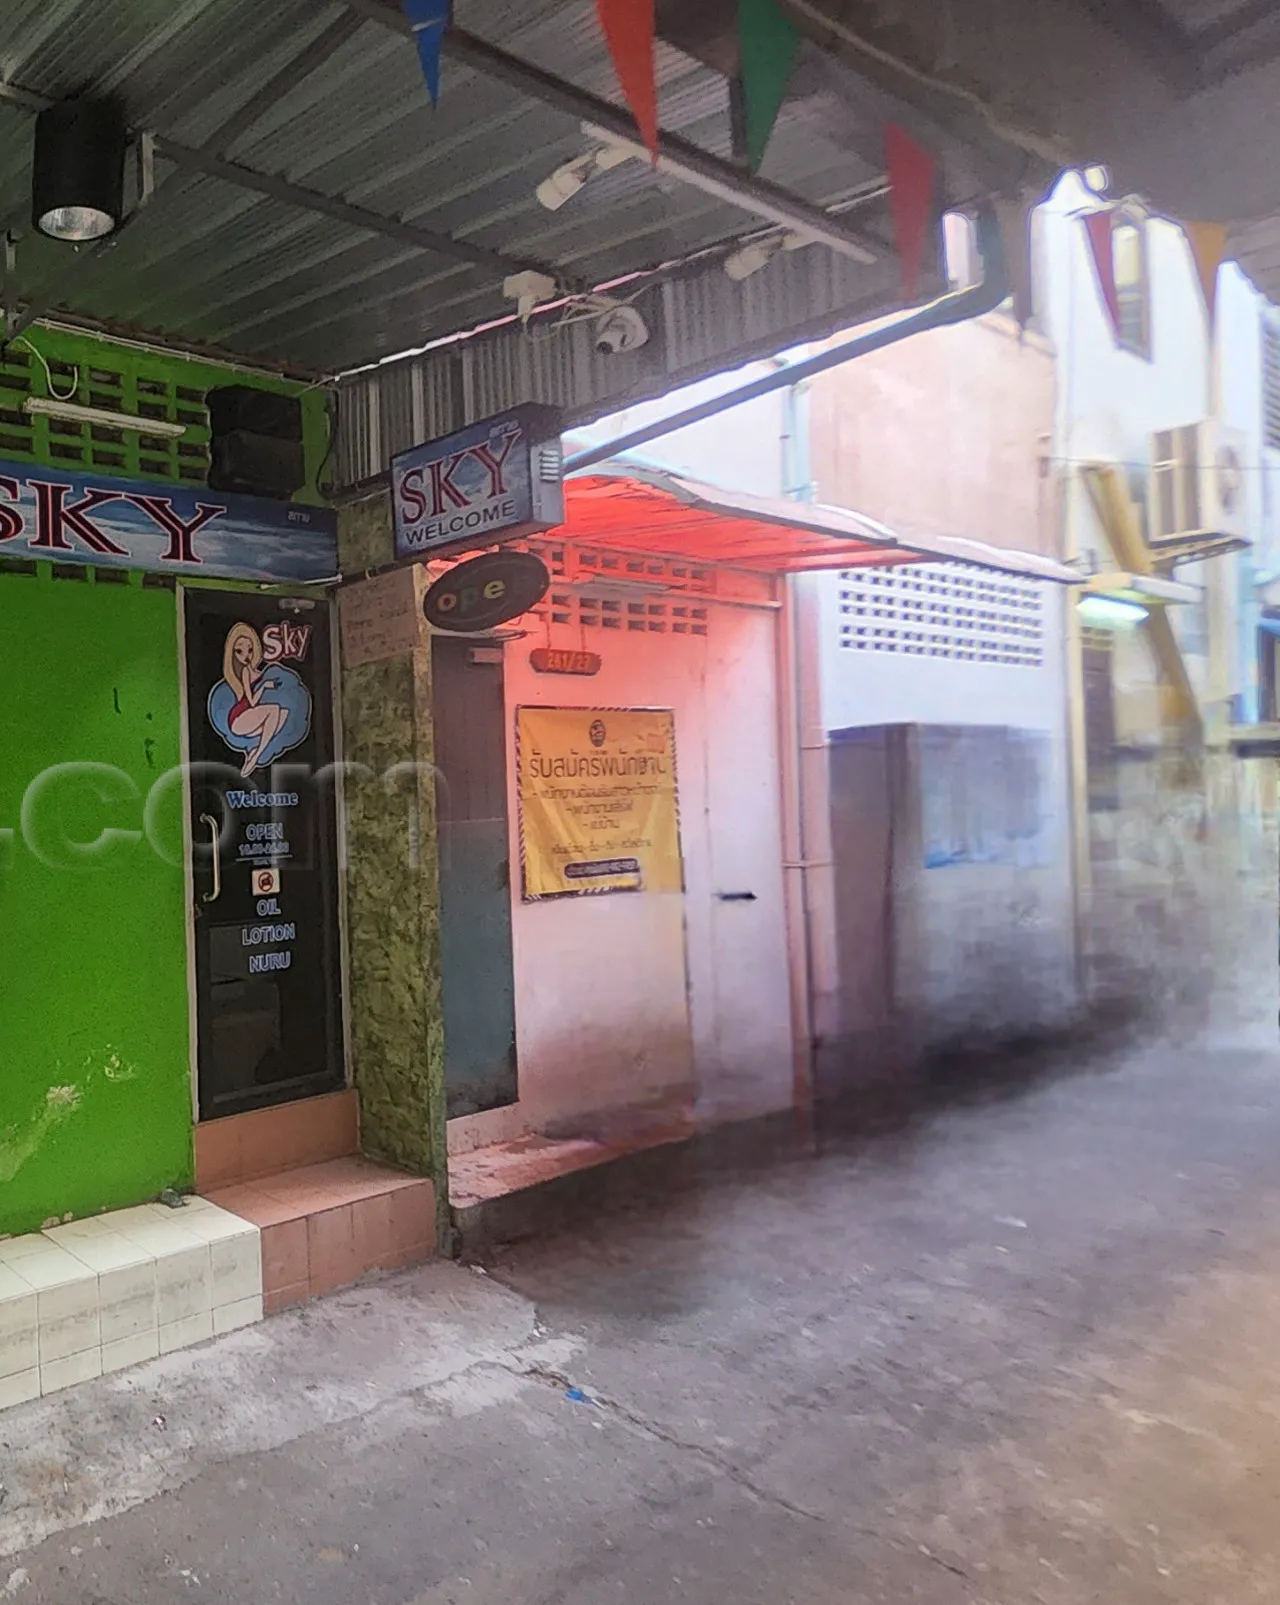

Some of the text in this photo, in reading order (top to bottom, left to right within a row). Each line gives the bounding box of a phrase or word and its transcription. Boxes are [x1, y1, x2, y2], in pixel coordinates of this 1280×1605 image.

[400, 428, 523, 525] SKY
[406, 500, 516, 545] WELCOME
[262, 620, 313, 663] Sky
[225, 789, 299, 809] Welcome
[245, 822, 284, 841] OPEN
[256, 898, 282, 917] OIL
[241, 922, 296, 946] LOTION
[248, 951, 292, 974] NURU
